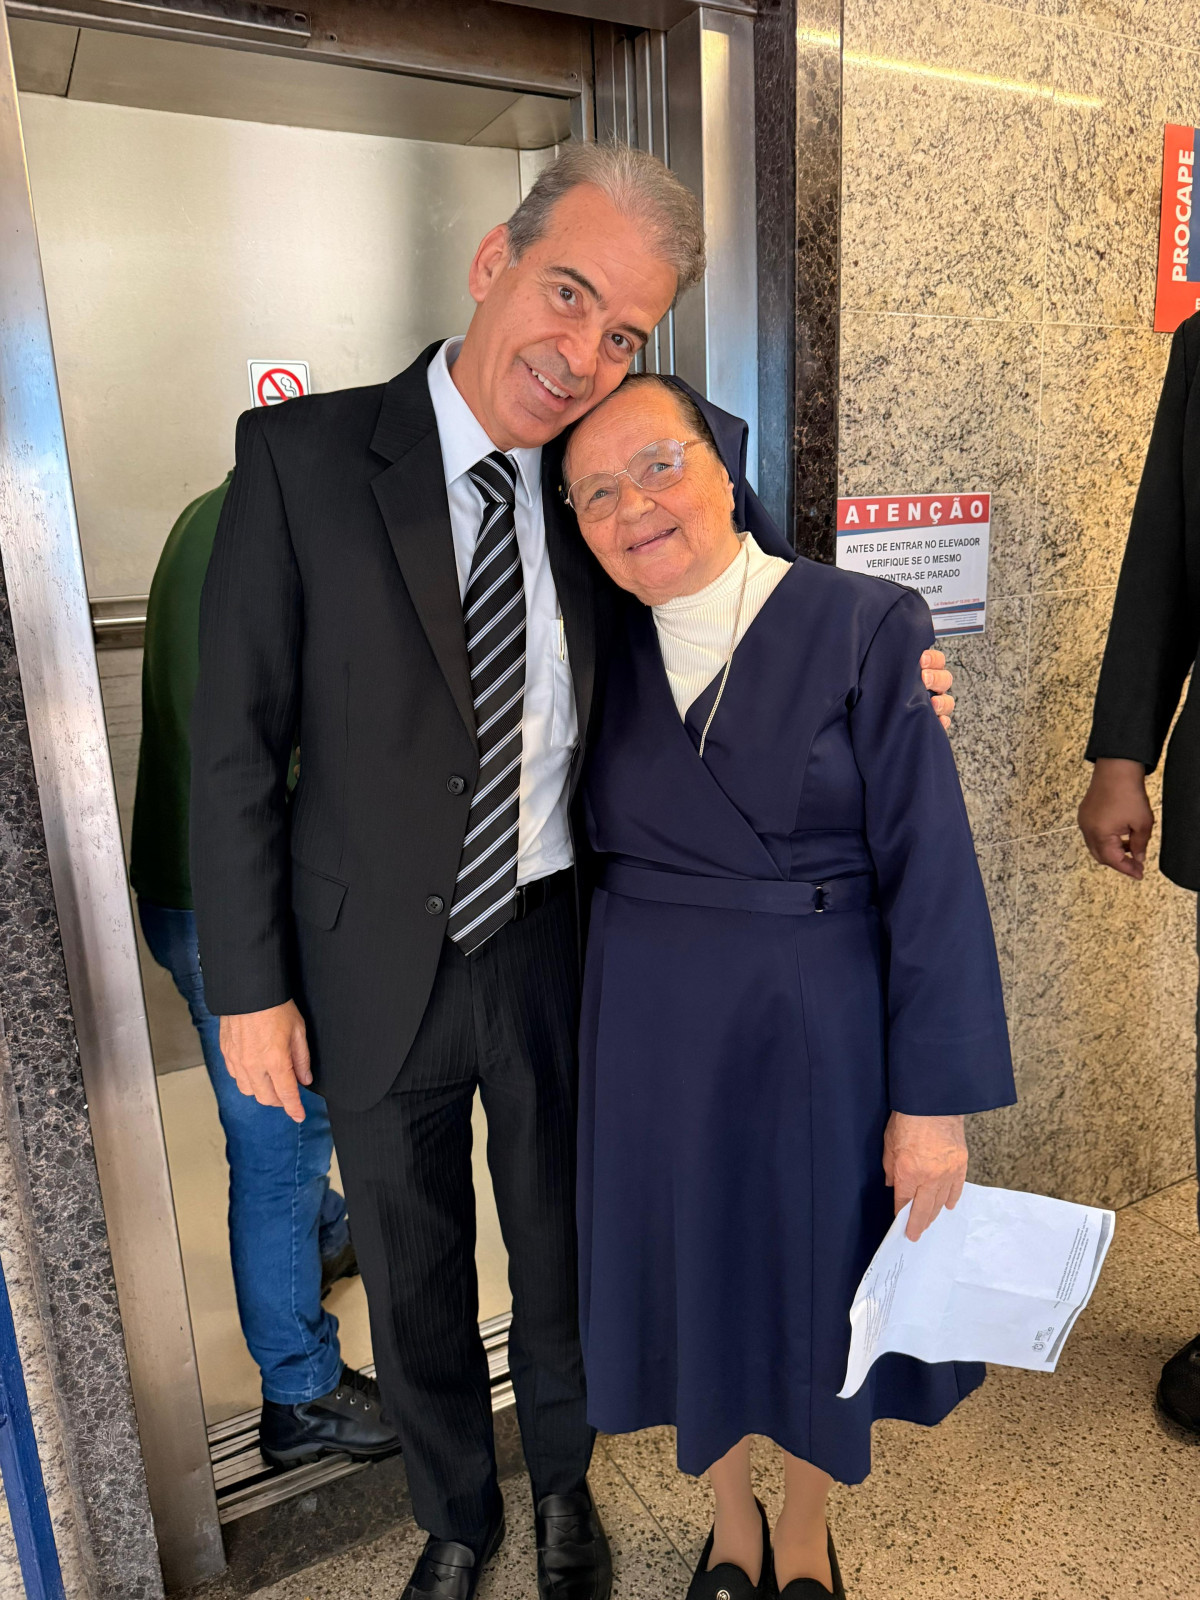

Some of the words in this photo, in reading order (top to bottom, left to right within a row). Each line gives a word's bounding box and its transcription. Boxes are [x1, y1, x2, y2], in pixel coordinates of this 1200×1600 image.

[1172, 149, 1195, 282] PROCAPE
[845, 497, 983, 525] ATENÇÃO
[846, 543, 874, 554] ANTES
[876, 542, 888, 552] DE
[890, 540, 922, 551] ENTRAR
[924, 539, 937, 549] NO
[938, 537, 980, 548] ELEVADOR
[866, 558, 909, 568] VERIFIQUE
[911, 556, 922, 566] SE
[923, 555, 930, 564] O
[932, 553, 962, 563] MESMO
[927, 568, 960, 579] PARADO
